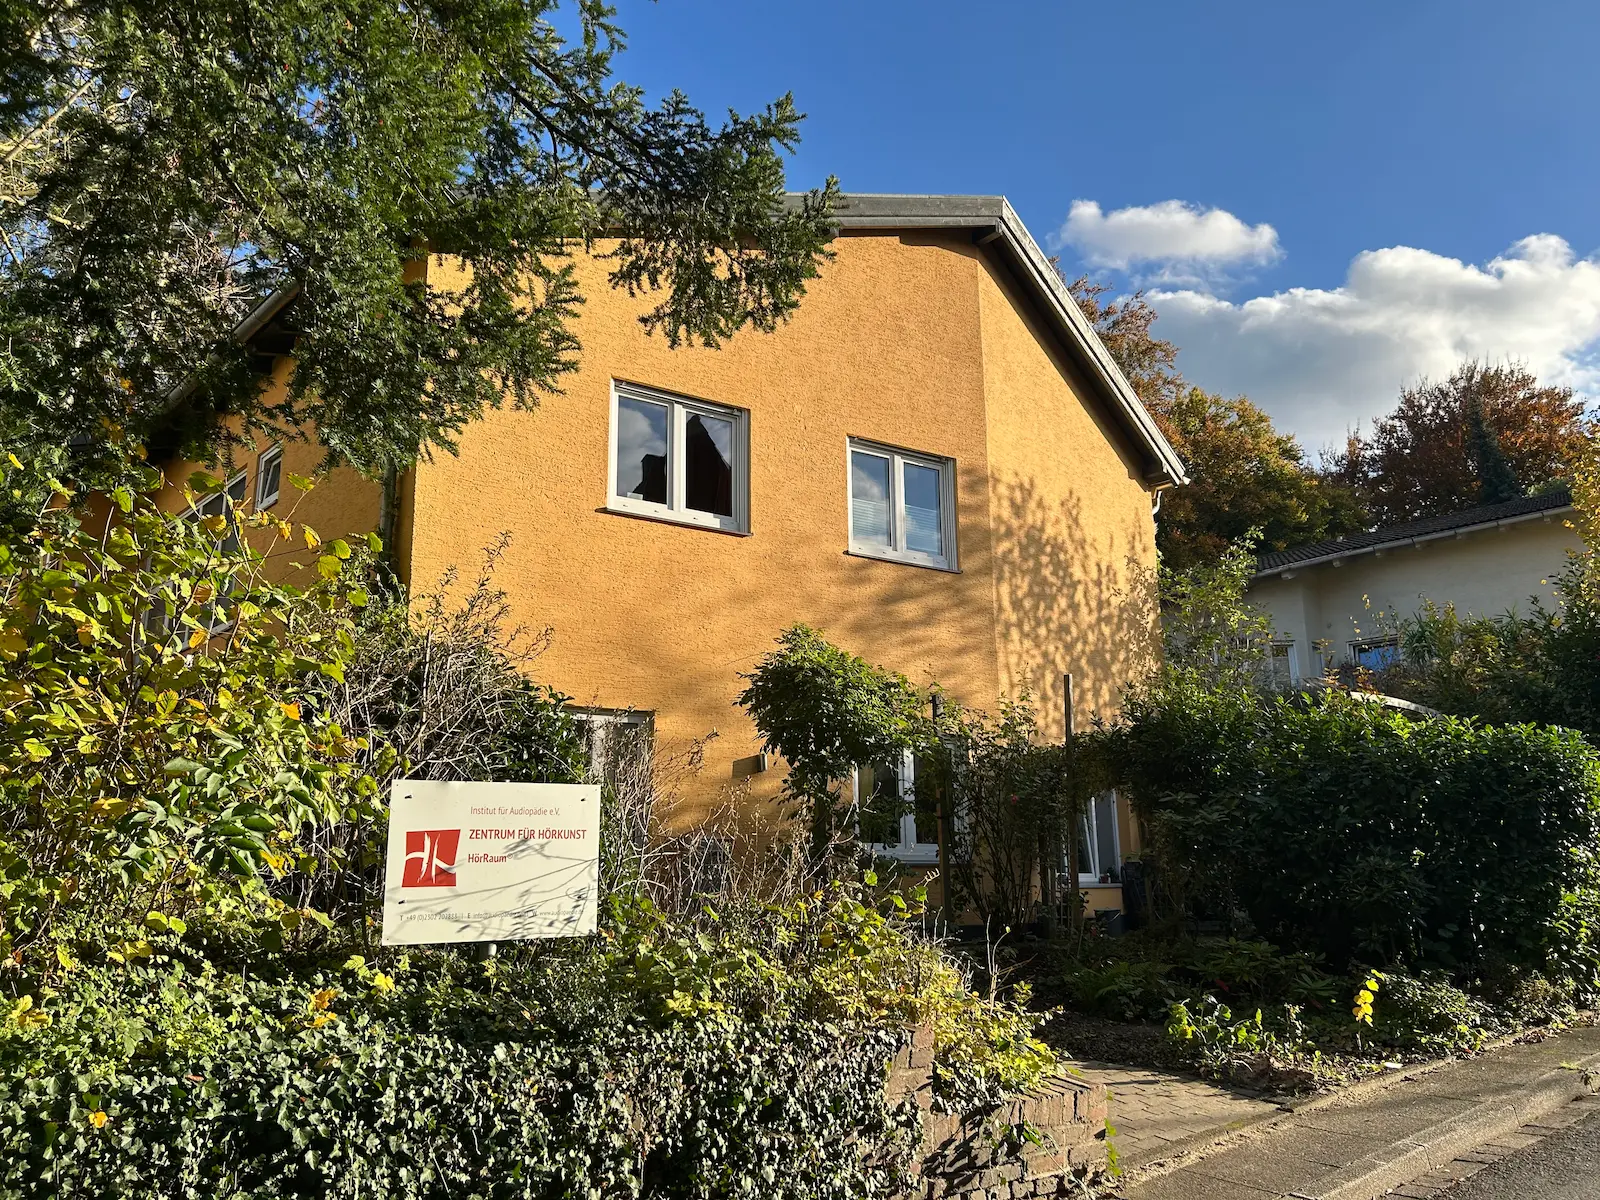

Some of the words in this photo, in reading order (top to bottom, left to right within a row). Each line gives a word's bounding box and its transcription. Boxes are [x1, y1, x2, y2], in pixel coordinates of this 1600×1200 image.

[470, 806, 496, 815] Institut
[498, 806, 508, 815] für
[509, 807, 548, 817] Audiopädie
[549, 808, 560, 816] e.V.
[469, 829, 515, 840] ZENTRUM
[518, 828, 536, 840] FÜR
[538, 828, 587, 840] HÖRKUNST
